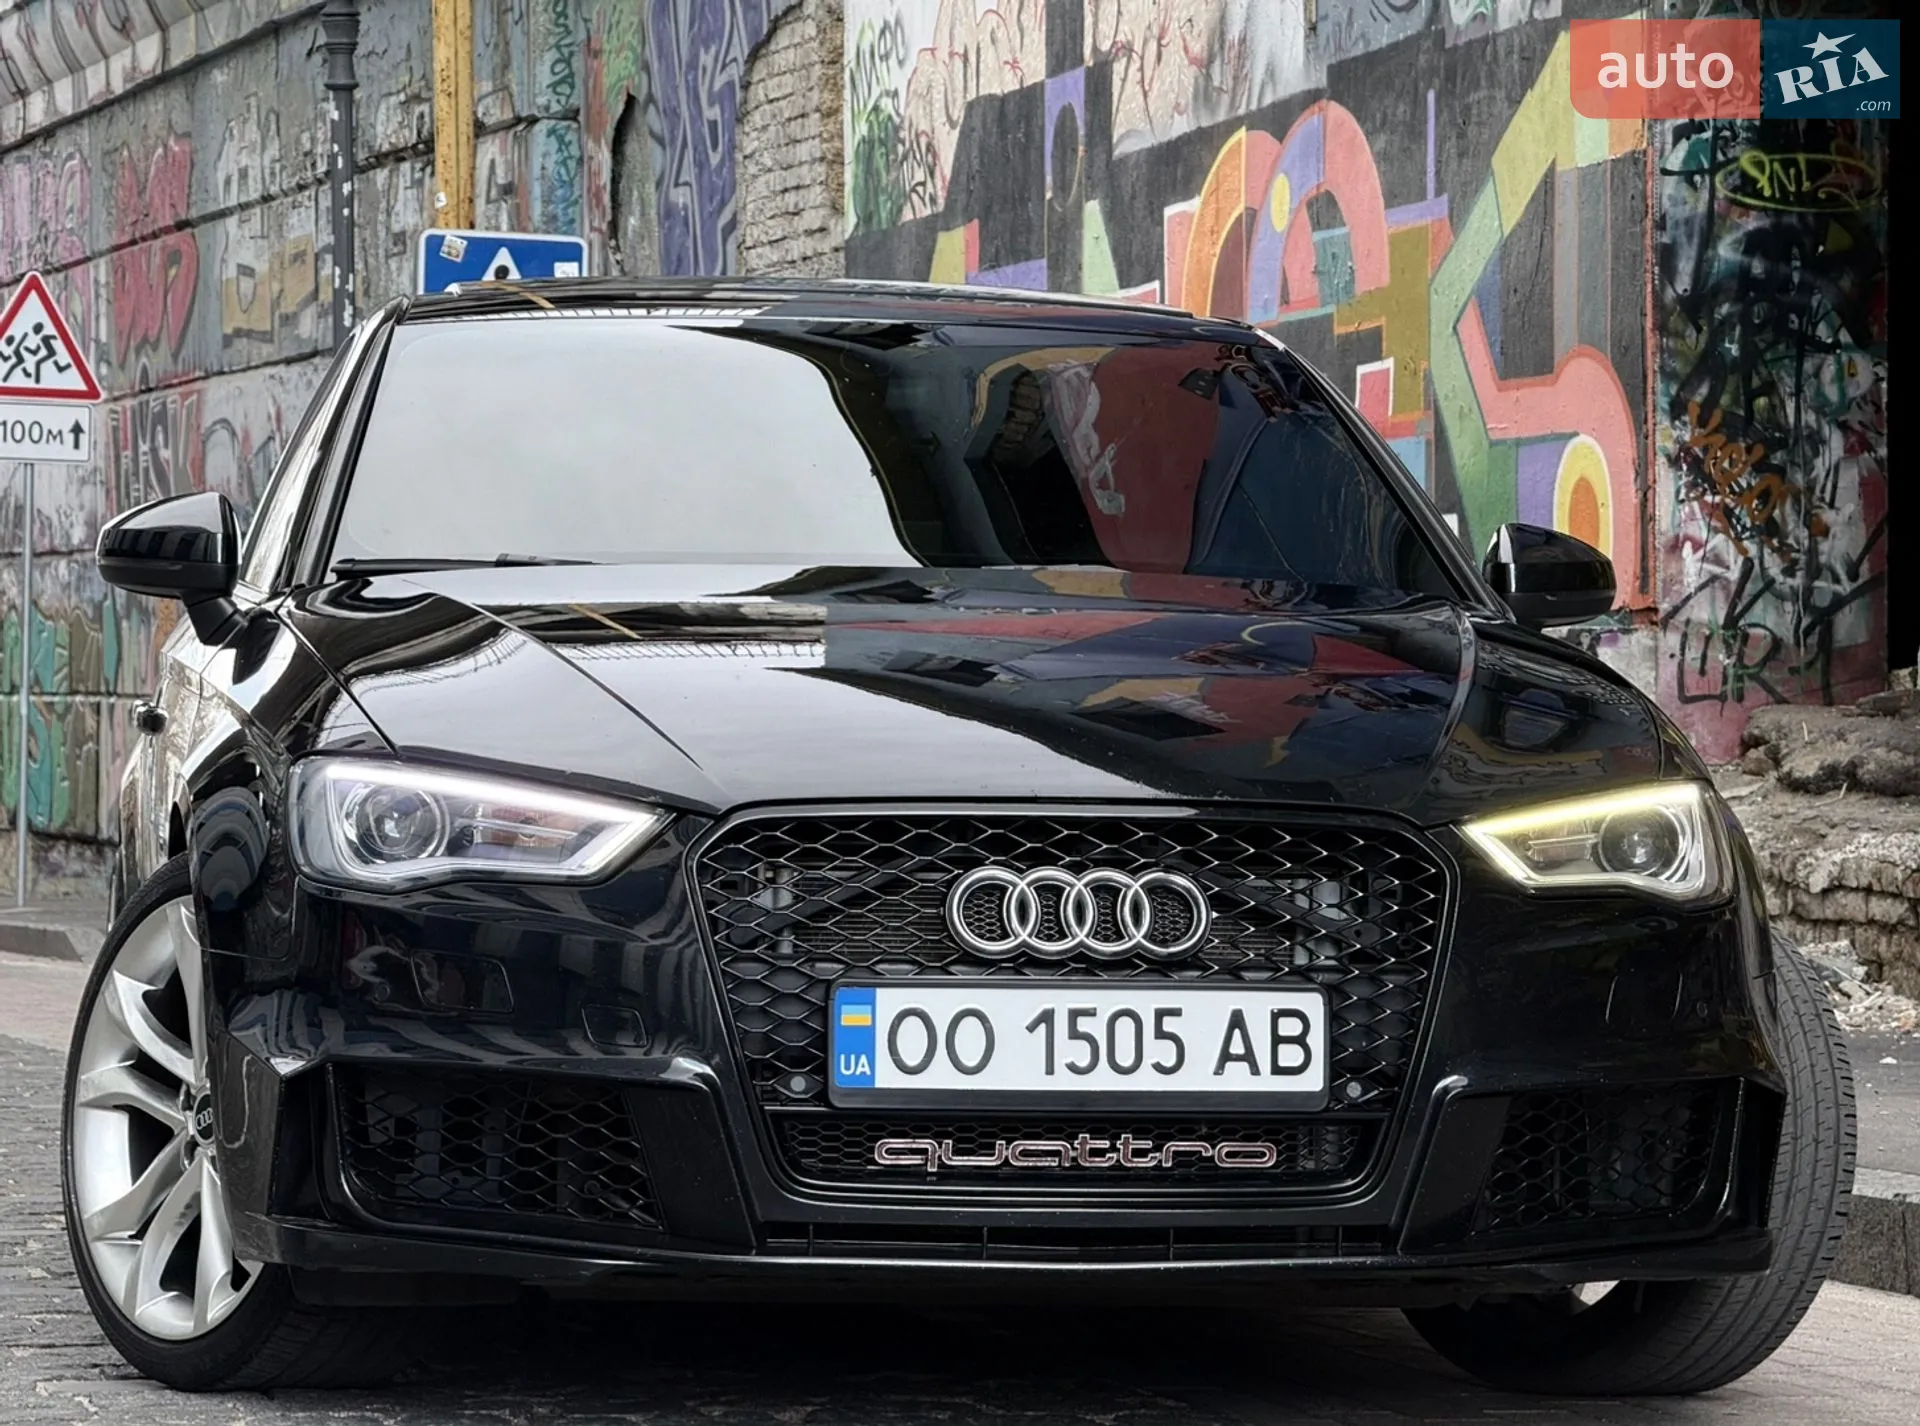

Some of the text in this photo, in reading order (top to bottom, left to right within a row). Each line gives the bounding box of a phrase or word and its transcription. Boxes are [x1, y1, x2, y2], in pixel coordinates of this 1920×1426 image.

[1025, 1007, 1186, 1076] 1505
[1212, 1007, 1312, 1076] AB
[840, 1054, 871, 1076] UA
[874, 1134, 1277, 1172] quattro
